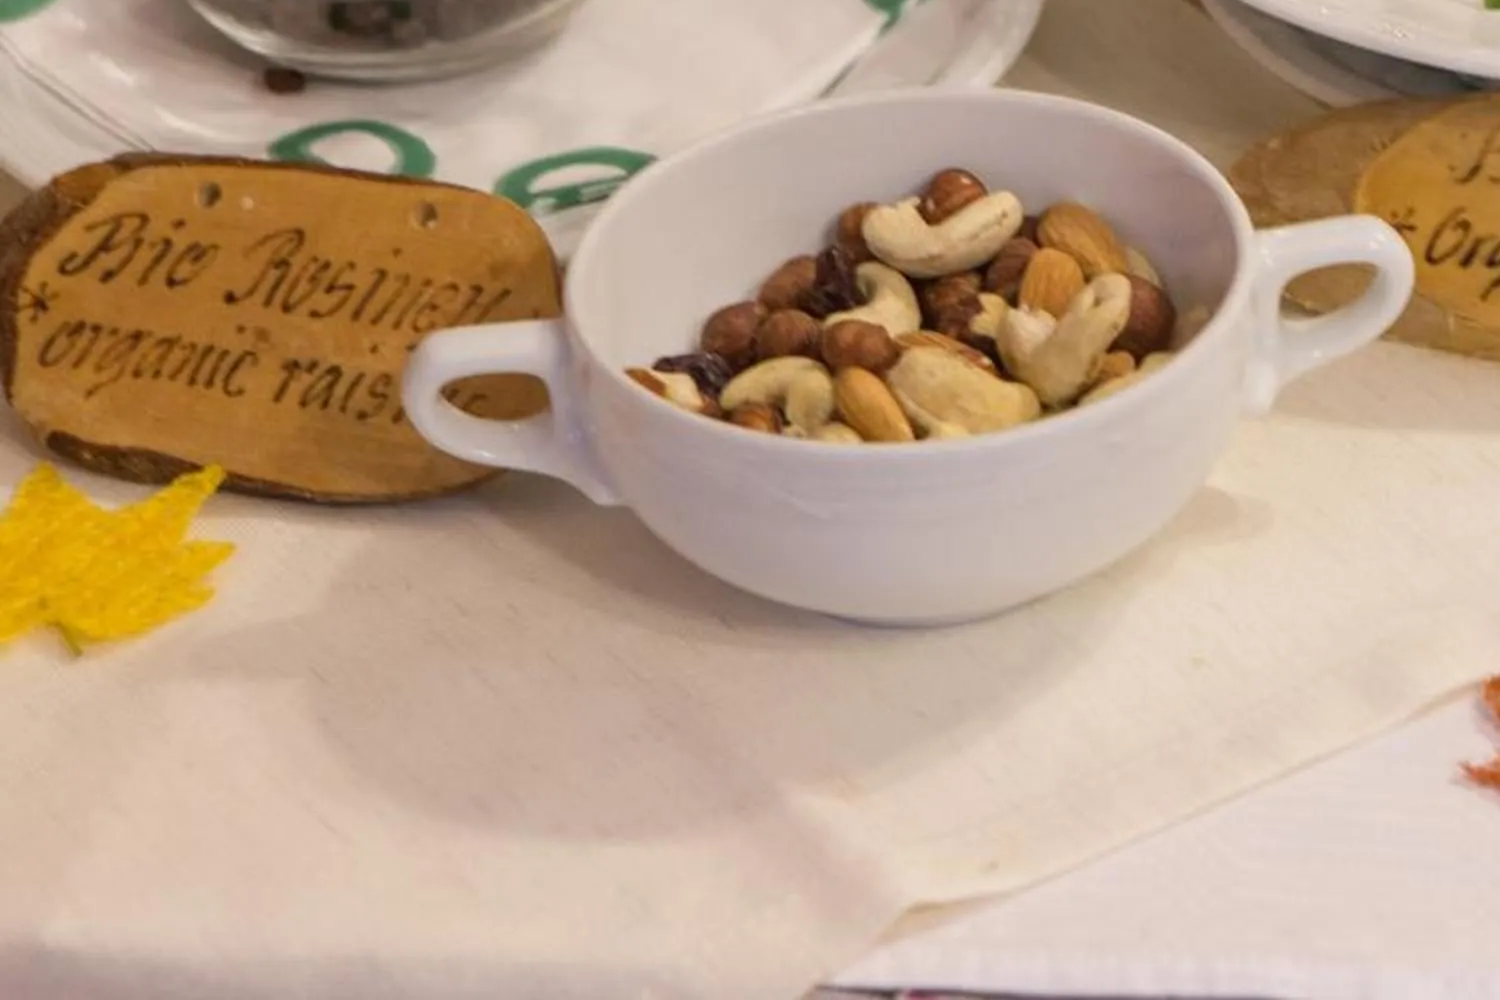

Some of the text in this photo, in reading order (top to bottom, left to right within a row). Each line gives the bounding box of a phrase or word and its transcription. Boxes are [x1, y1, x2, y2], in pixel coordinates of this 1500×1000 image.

[57, 211, 512, 333] Bio Rosinen
[38, 319, 488, 425] organic rais
